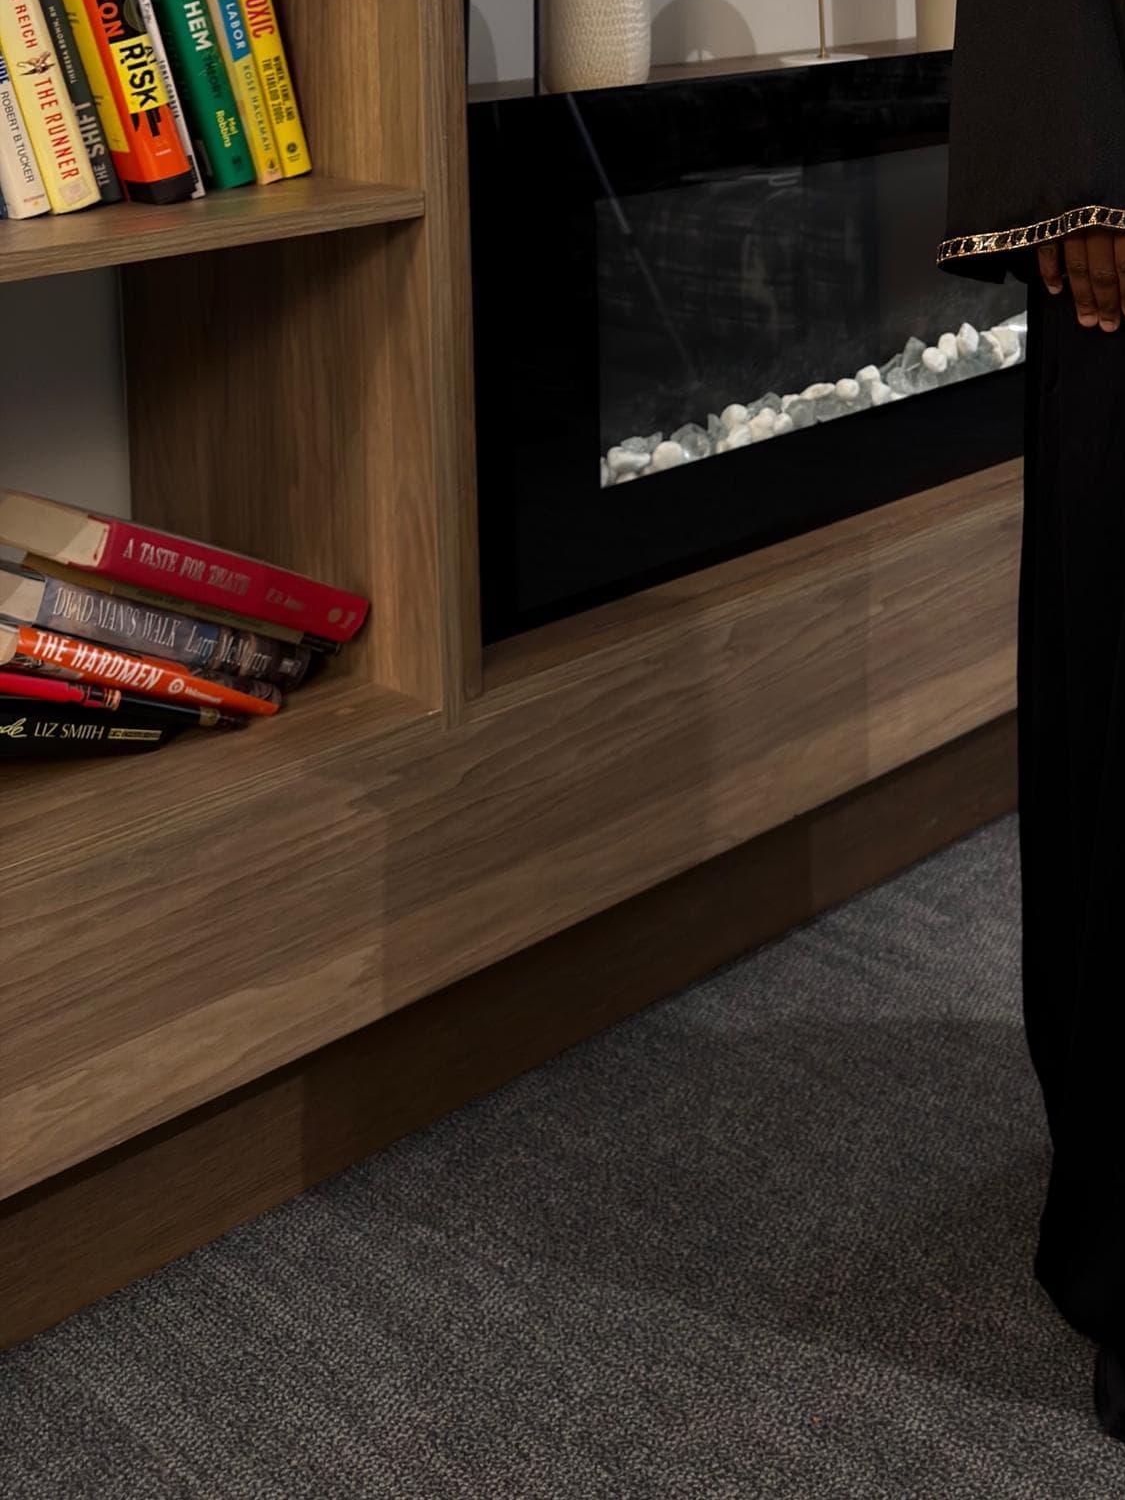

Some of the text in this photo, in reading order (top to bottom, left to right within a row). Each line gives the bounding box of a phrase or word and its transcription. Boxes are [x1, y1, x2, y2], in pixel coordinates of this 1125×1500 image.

[14, 4, 38, 49] REICH
[53, 19, 67, 49] BROWN,
[226, 2, 246, 50] LABOR
[62, 51, 77, 84] THERESA
[119, 42, 159, 108] RISK
[34, 77, 80, 180] THE RUNNER
[216, 110, 232, 148] Robbins
[227, 117, 239, 135] Mel
[243, 64, 272, 152] ROSE HACKMAN
[1, 91, 19, 132] ROBERT
[17, 142, 35, 184] TUCKER
[73, 102, 110, 186] THE SHIFT
[123, 538, 134, 559] A
[139, 541, 179, 573] TASTE
[179, 556, 206, 581] FOR
[53, 587, 94, 623] DEAD
[94, 599, 140, 635] MAN'S
[142, 612, 181, 647] WALK
[186, 625, 217, 664] Larry
[32, 631, 165, 690] THE HARDMEN
[34, 722, 60, 738] LIZ
[61, 724, 104, 740] SMITH
